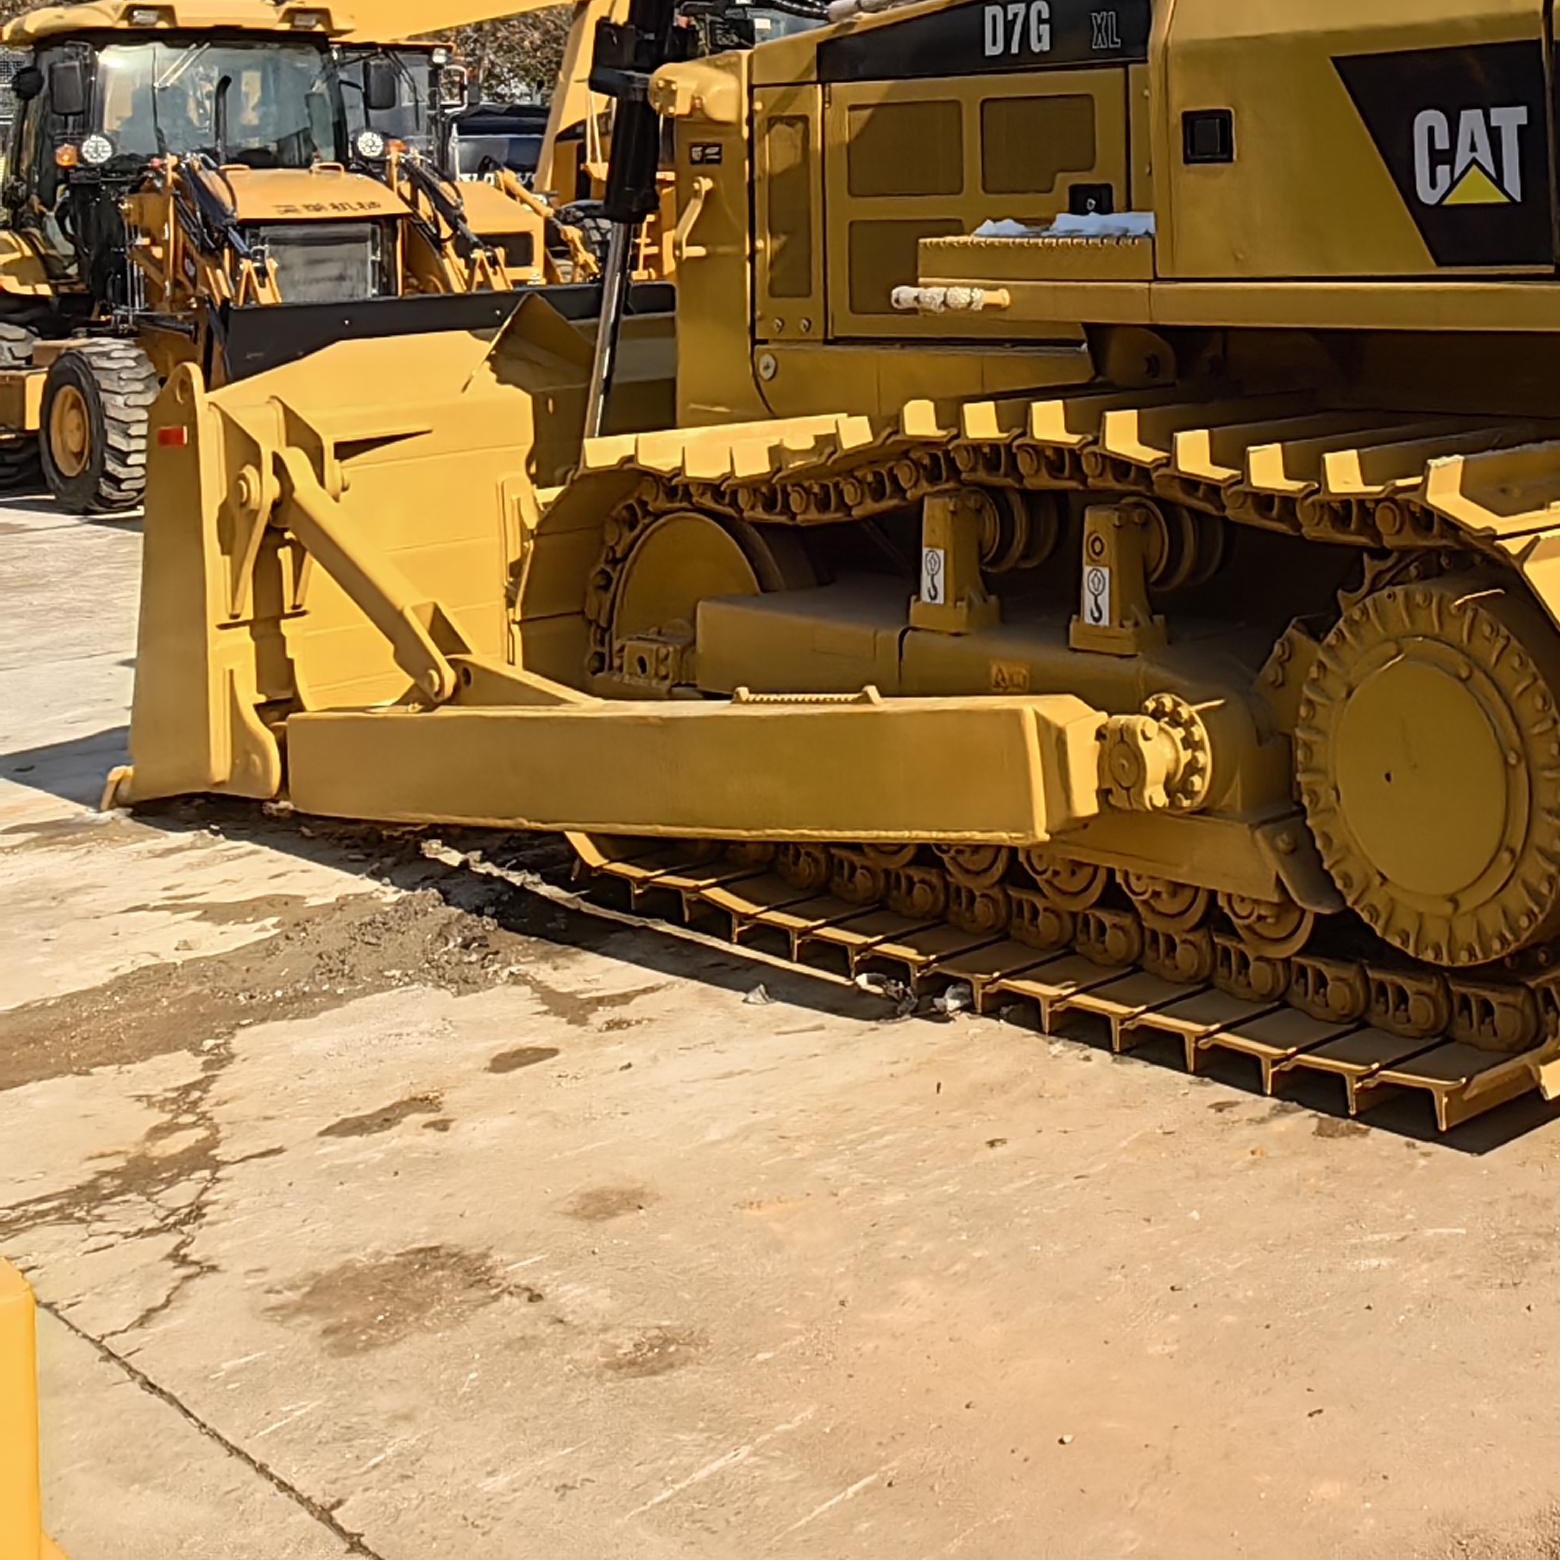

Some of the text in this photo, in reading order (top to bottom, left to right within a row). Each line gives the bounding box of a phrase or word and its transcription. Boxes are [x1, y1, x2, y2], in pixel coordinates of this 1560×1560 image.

[984, 0, 1121, 57] D7G XL
[1413, 105, 1528, 206] CAT
